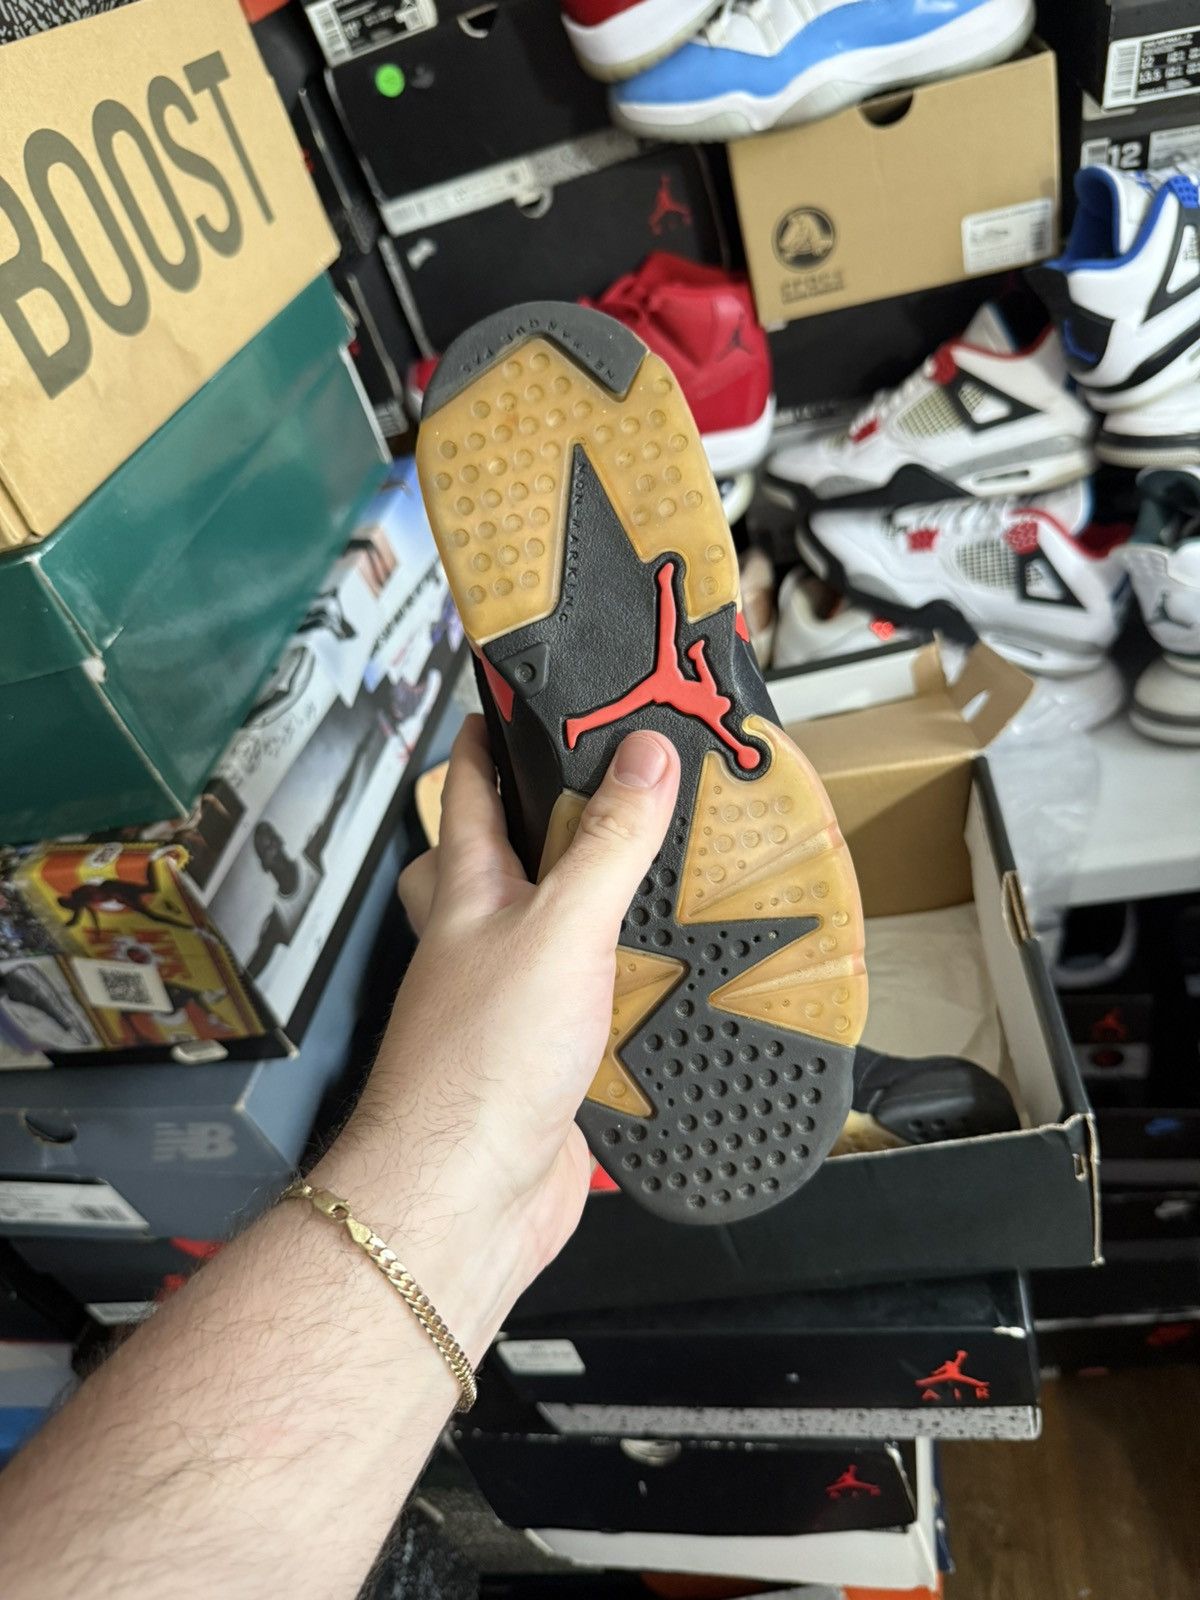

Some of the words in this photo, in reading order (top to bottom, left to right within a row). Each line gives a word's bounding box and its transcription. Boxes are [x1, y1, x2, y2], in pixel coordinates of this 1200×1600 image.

[1108, 141, 1143, 169] 12
[0, 51, 274, 400] BOOST
[921, 1386, 991, 1402] AIR
